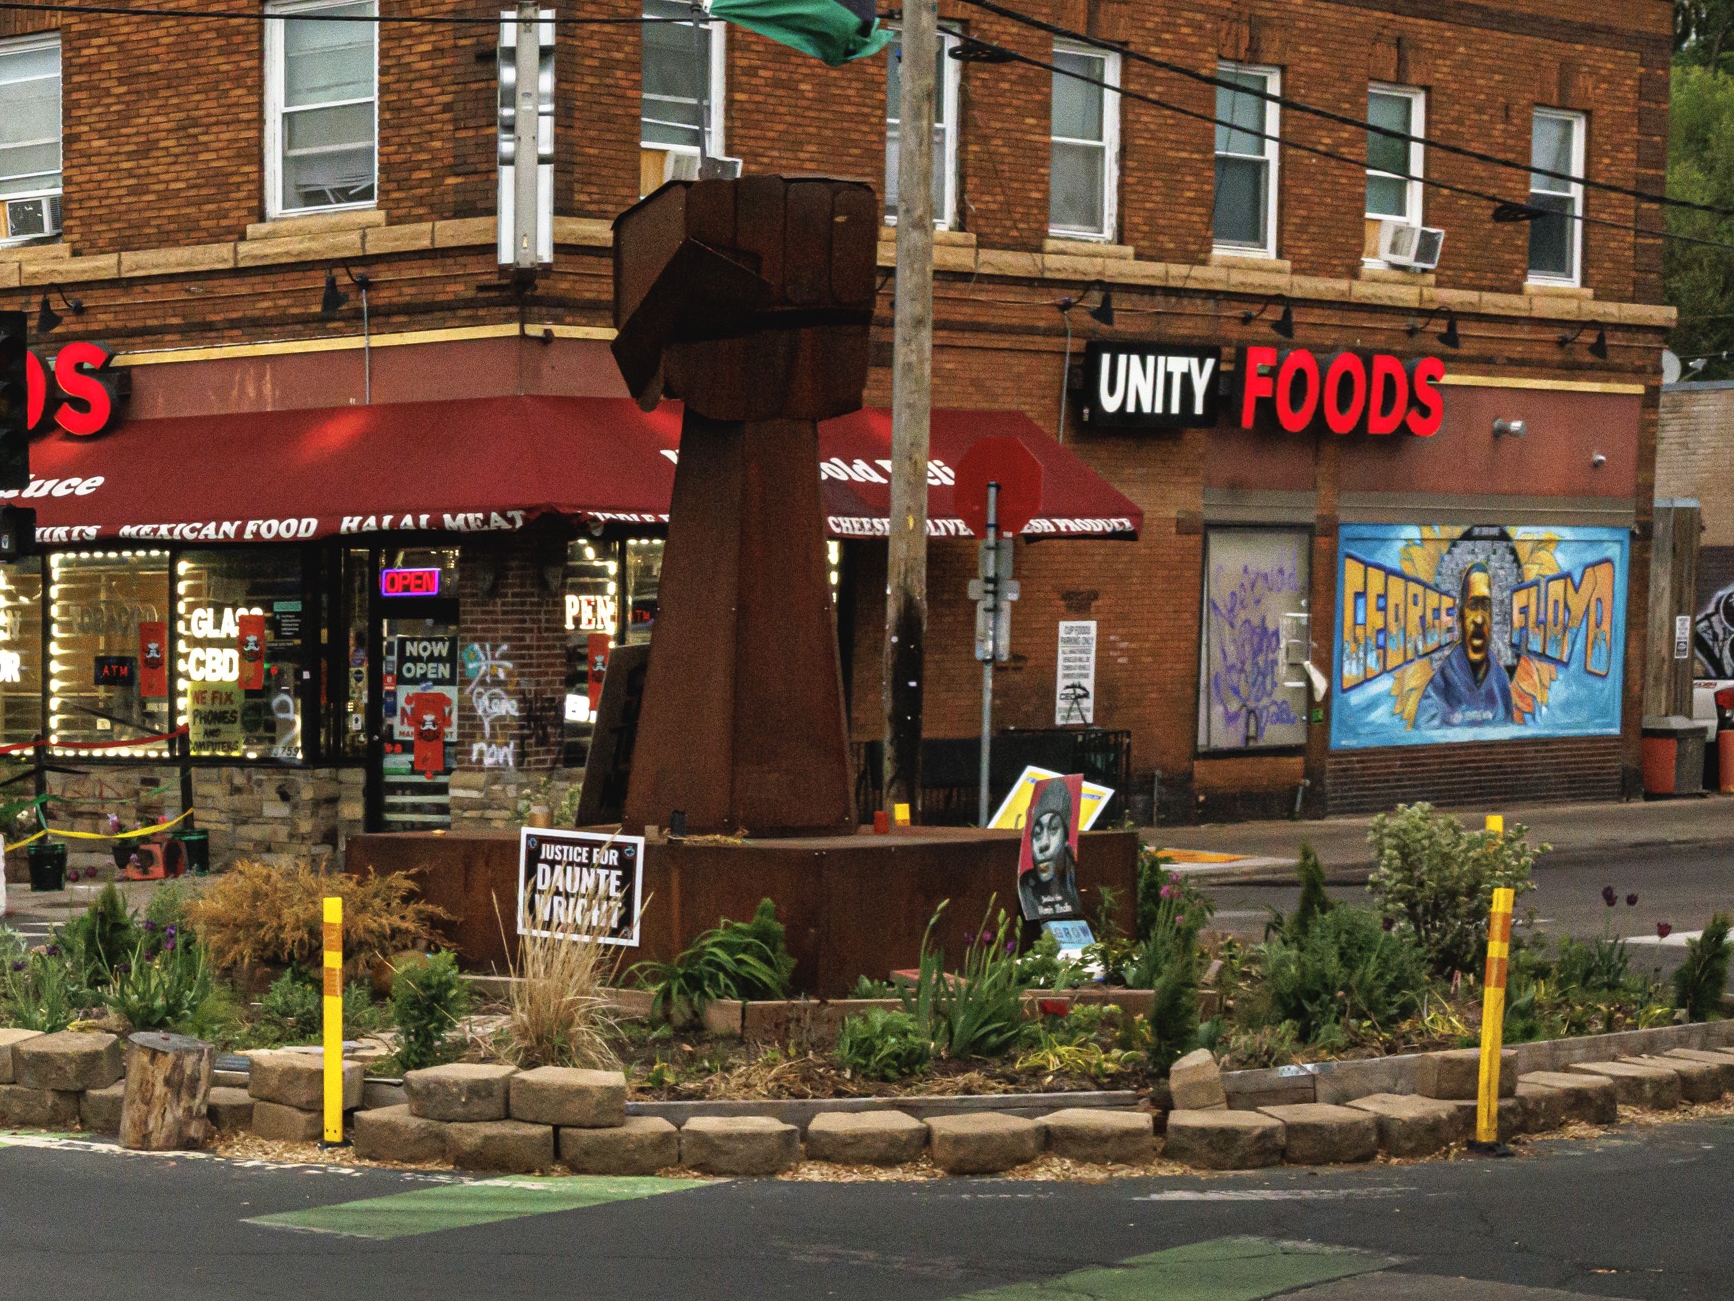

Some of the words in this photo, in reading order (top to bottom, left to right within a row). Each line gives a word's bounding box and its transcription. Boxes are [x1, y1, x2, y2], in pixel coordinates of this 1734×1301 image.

[1099, 353, 1216, 415] UNITY
[1241, 346, 1446, 437] FOODS
[119, 520, 243, 541] MEXICAN
[243, 518, 319, 540] FOOD
[340, 513, 436, 534] HALAL
[443, 510, 529, 533] MEAT
[1055, 517, 1135, 534] PRODUCE
[385, 571, 436, 594] OPEN
[1341, 549, 1457, 695] GEORGE
[1511, 557, 1616, 680] FLOYD
[405, 640, 450, 659] NOW
[102, 665, 129, 677] ATM
[188, 647, 240, 682] CBD
[402, 662, 451, 679] OPEN
[210, 691, 235, 705] FIX
[192, 709, 238, 726] PHONES
[540, 843, 590, 864] JUSTICE
[592, 847, 620, 866] FOR
[536, 862, 623, 899] DAUNTE
